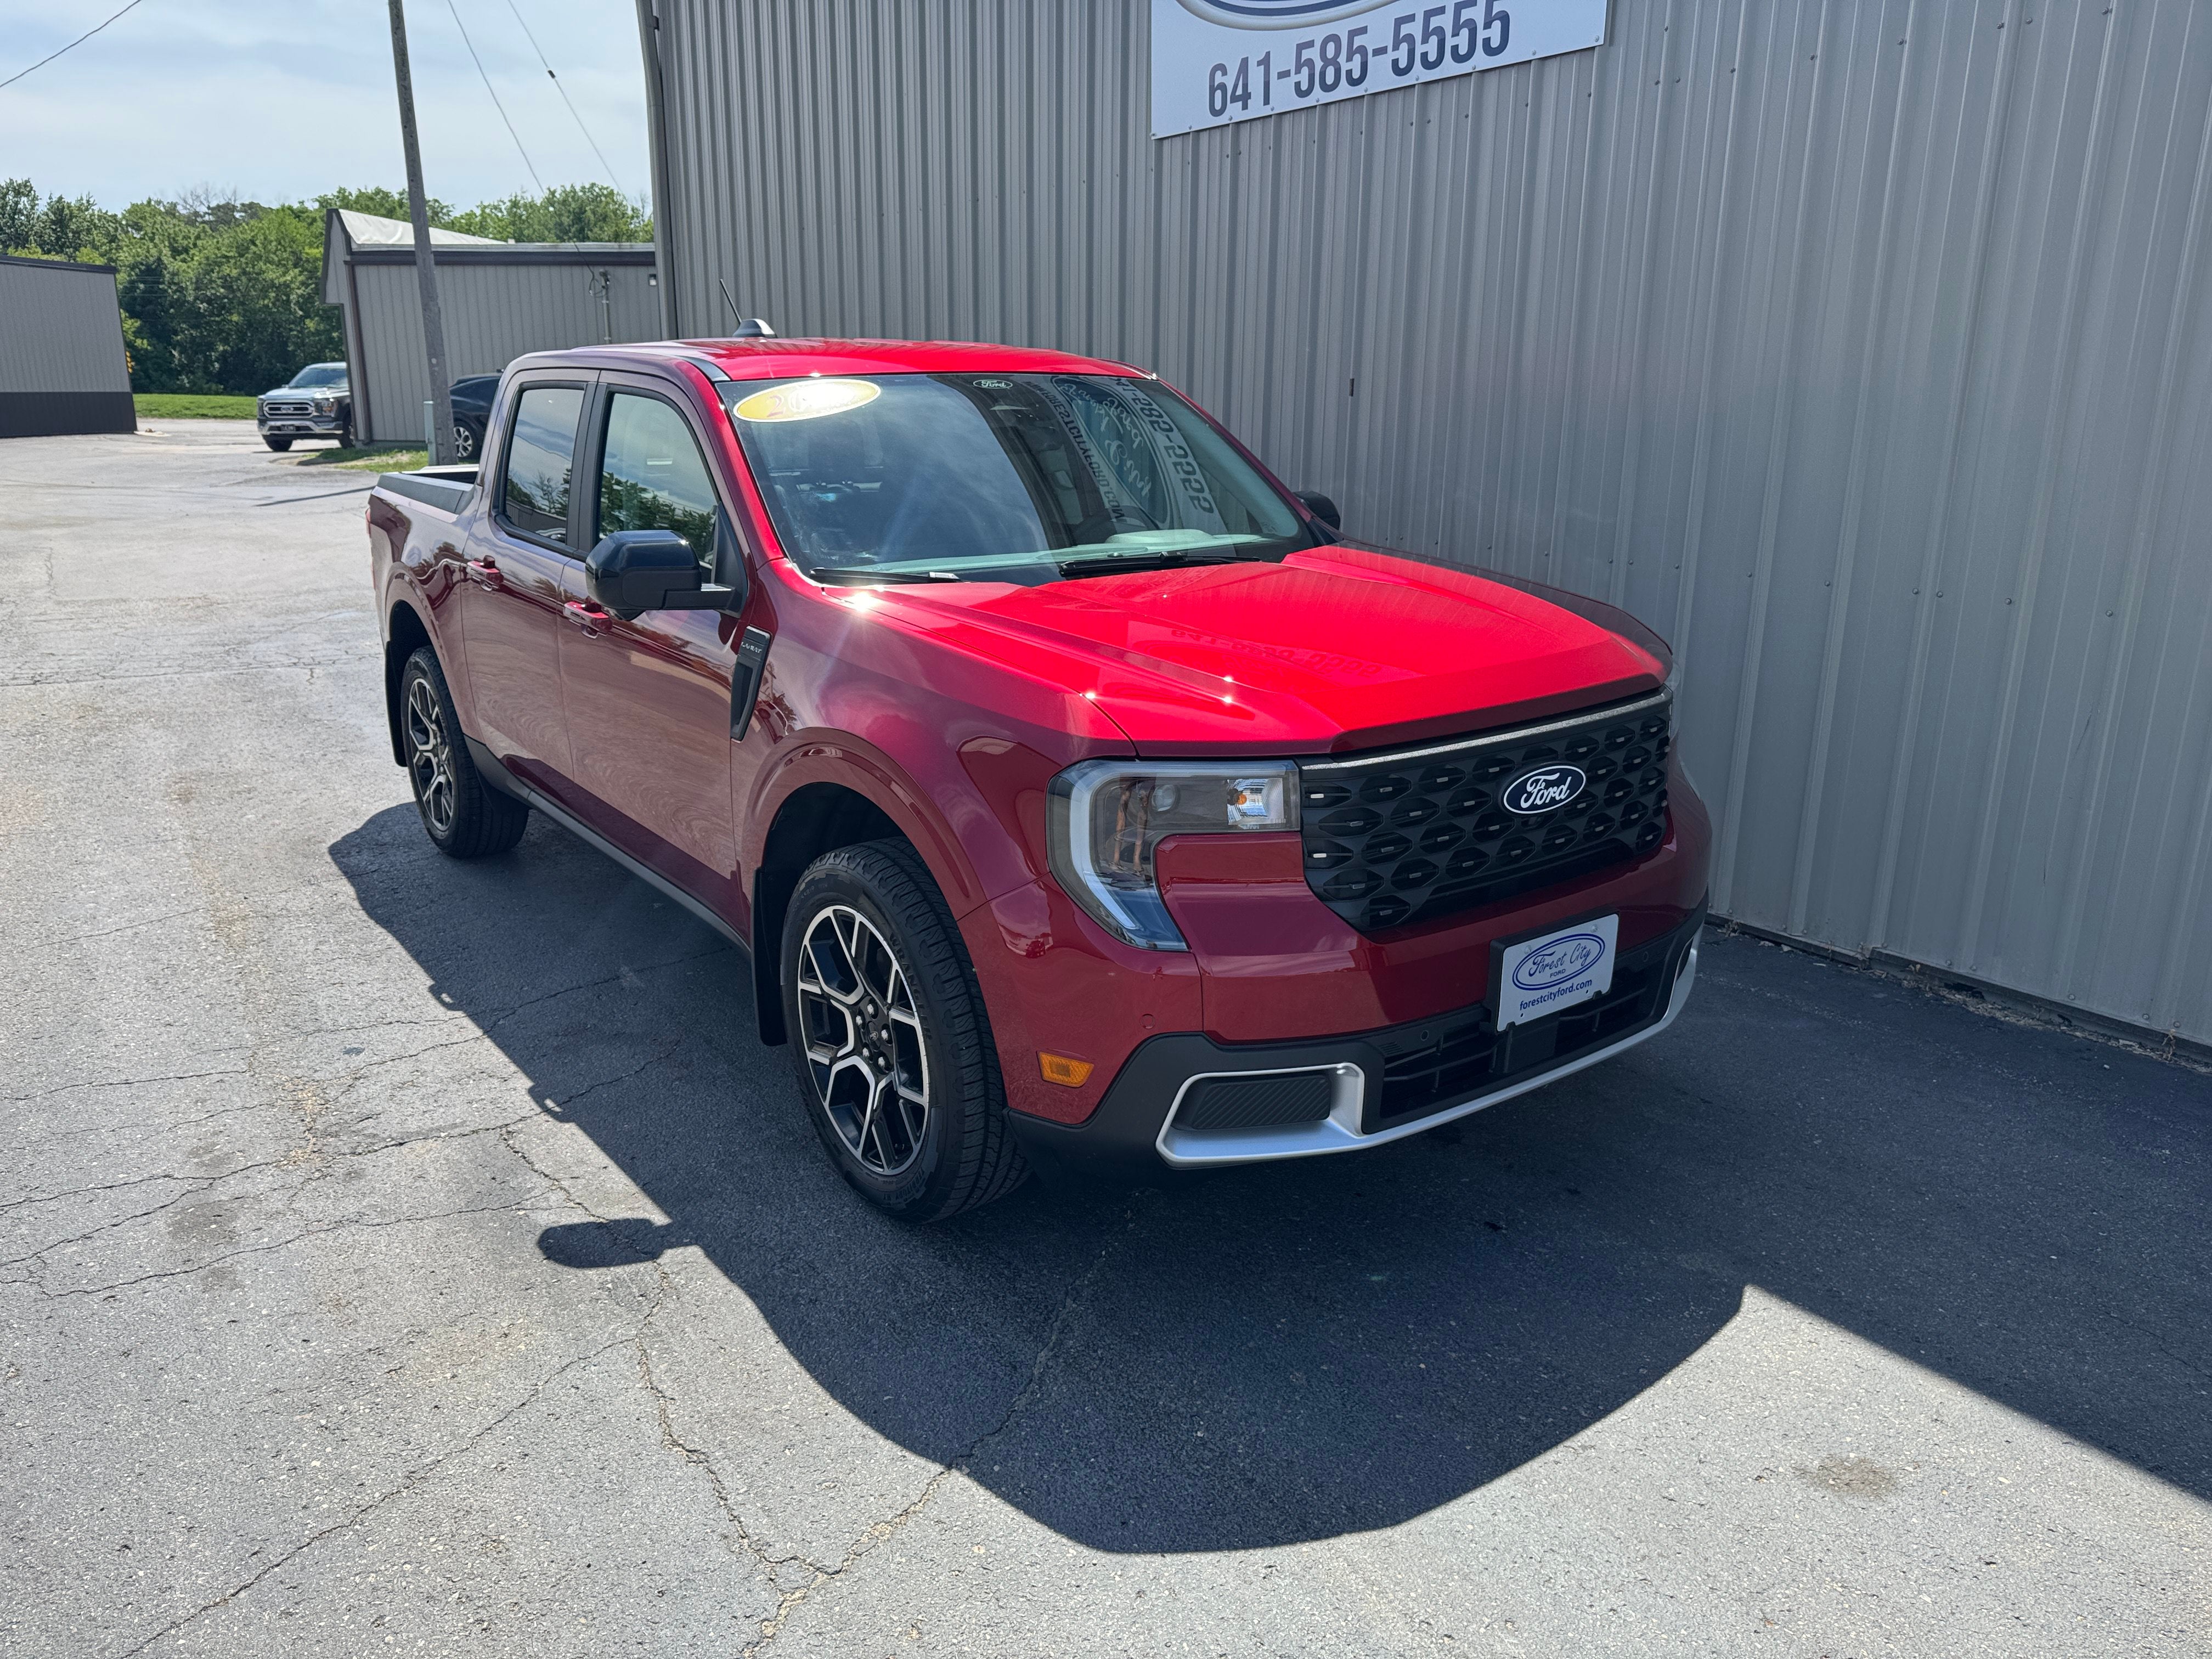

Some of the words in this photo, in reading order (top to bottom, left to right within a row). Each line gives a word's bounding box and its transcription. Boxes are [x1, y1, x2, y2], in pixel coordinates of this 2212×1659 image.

[1209, 0, 1510, 117] 641-585-5555
[1520, 772, 1572, 808] Ford
[1528, 951, 1567, 977] Forest
[1570, 943, 1592, 967] City
[1550, 968, 1566, 978] FORD
[1520, 979, 1593, 1011] forestcityford.com
